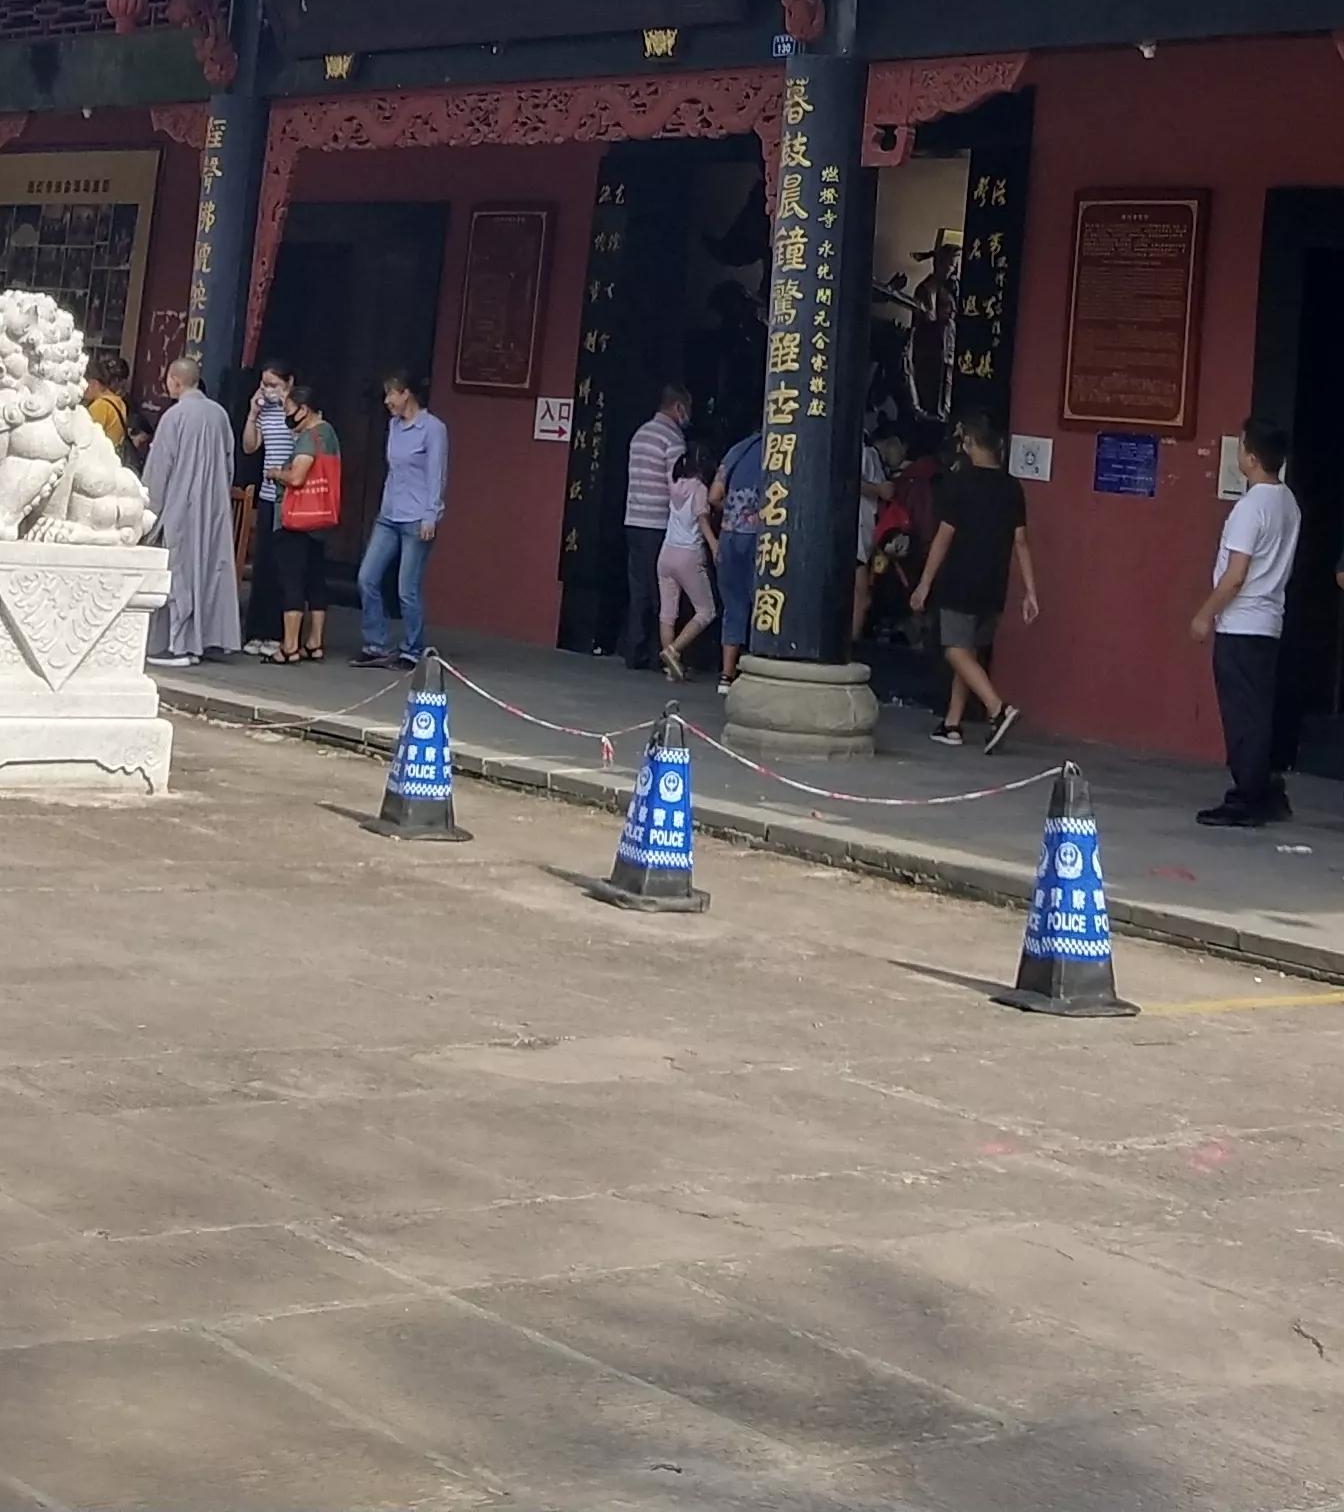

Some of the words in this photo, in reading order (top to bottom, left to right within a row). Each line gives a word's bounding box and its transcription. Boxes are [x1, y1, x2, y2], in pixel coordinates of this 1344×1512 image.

[540, 401, 572, 421] 入口
[404, 763, 436, 780] POLICE
[650, 828, 685, 847] POLICE
[1047, 914, 1087, 934] POLICE
